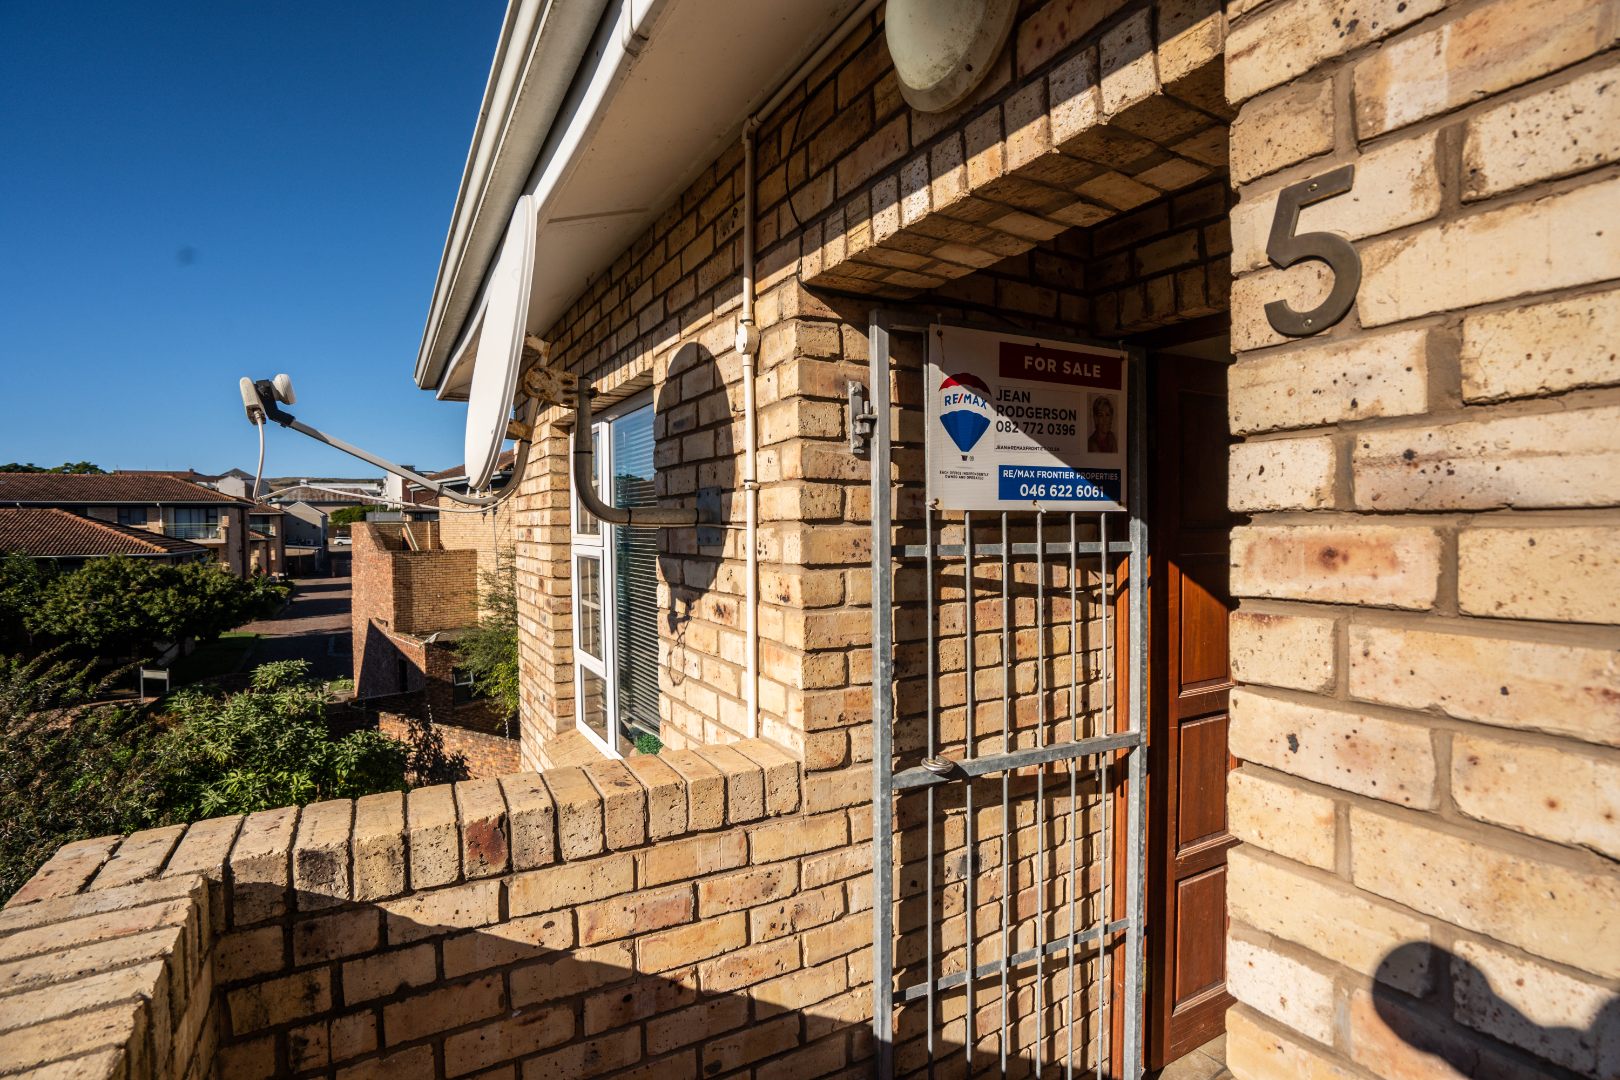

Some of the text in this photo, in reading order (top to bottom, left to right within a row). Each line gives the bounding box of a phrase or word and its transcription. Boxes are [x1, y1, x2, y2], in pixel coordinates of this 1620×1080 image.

[1263, 163, 1362, 338] 5
[1024, 355, 1101, 378] FOR SALE
[944, 393, 987, 410] RE/MAX
[996, 389, 1031, 403] JEAN
[996, 404, 1077, 421] RODGERSON
[995, 420, 1076, 436] 082 772 0396
[1003, 469, 1119, 481] RE/MAX FRONTIER PROPERTIES
[1019, 483, 1104, 499] 046 622 6061
